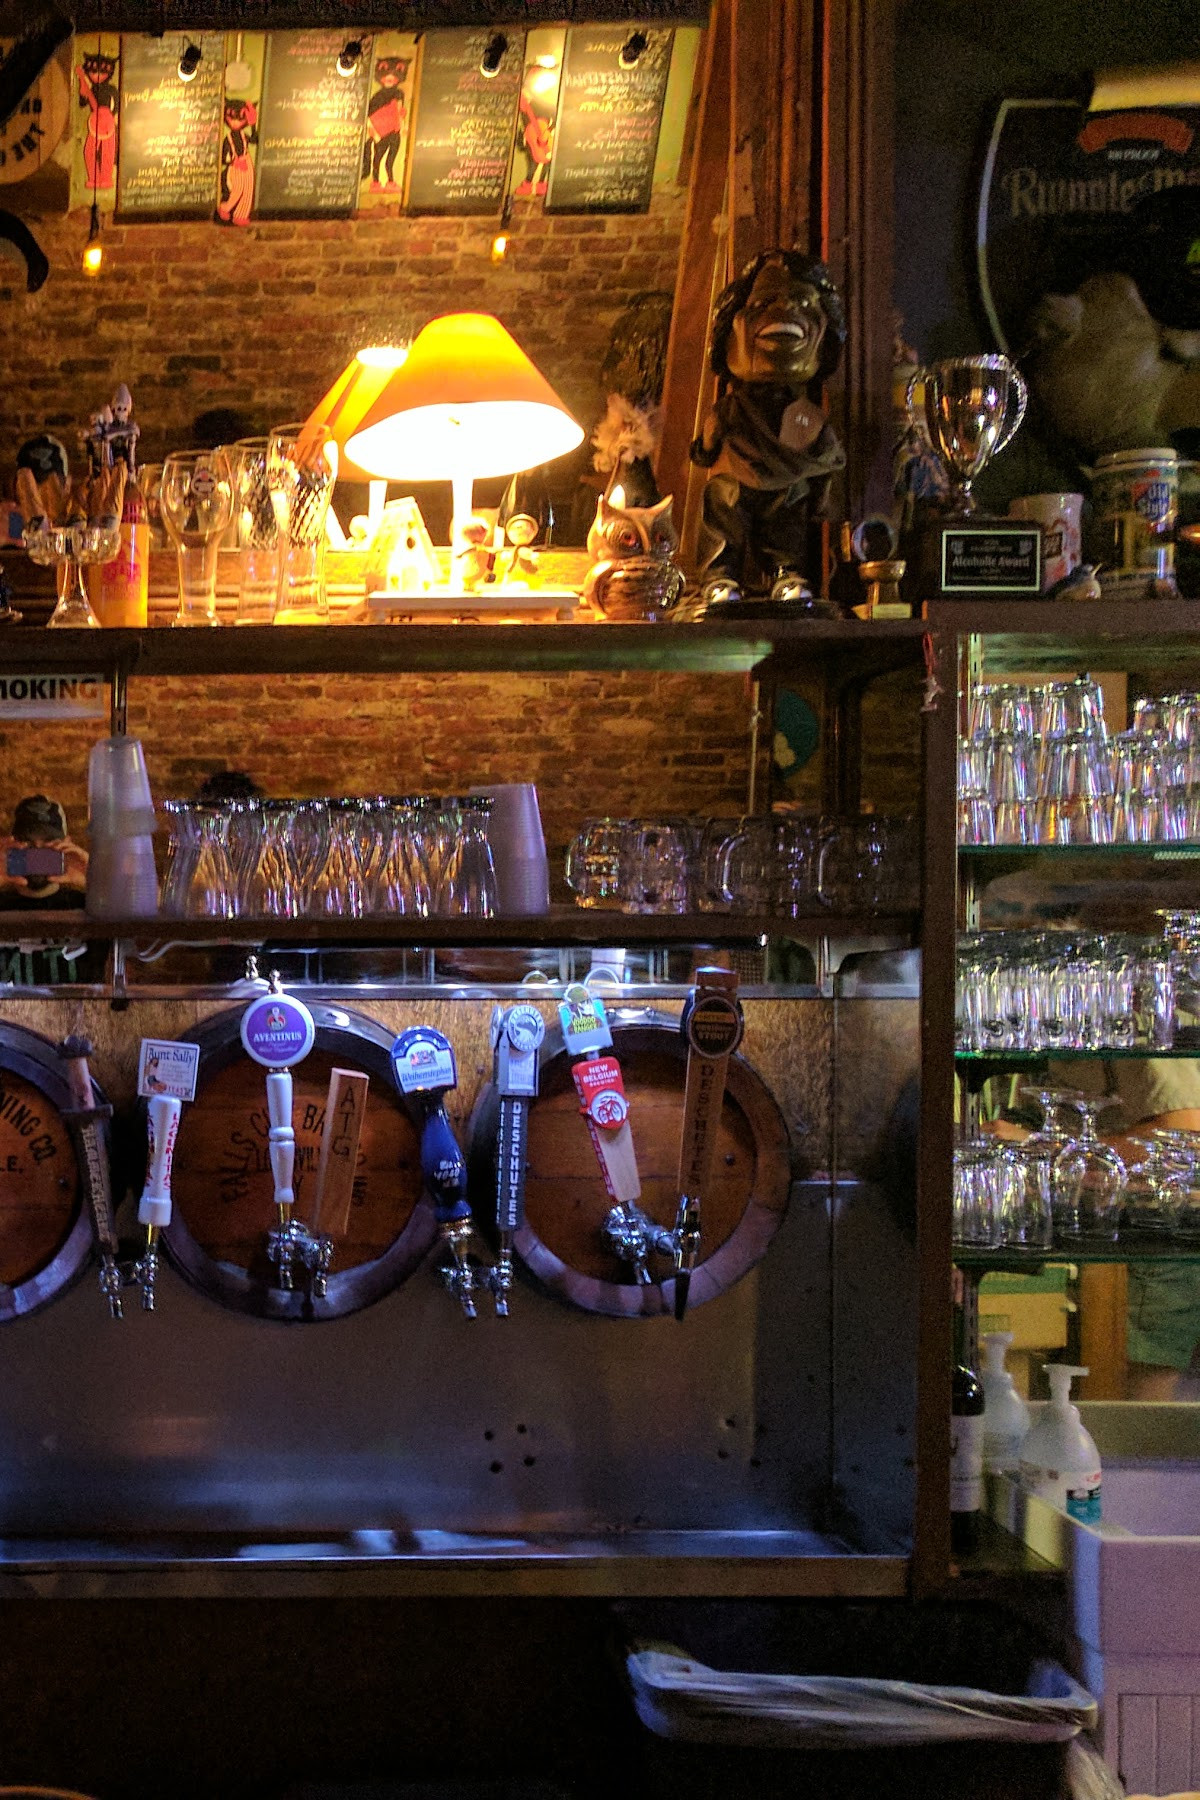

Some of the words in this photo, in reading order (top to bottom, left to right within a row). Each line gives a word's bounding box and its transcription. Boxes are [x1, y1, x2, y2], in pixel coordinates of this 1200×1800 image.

[997, 555, 1030, 568] Award
[253, 1031, 302, 1043] AVENTINUS
[149, 1047, 171, 1061] Aunt
[173, 1050, 195, 1066] Sally
[588, 1063, 608, 1074] NEW
[583, 1070, 619, 1084] BELGIUM
[507, 1101, 522, 1226] DESCHUTES
